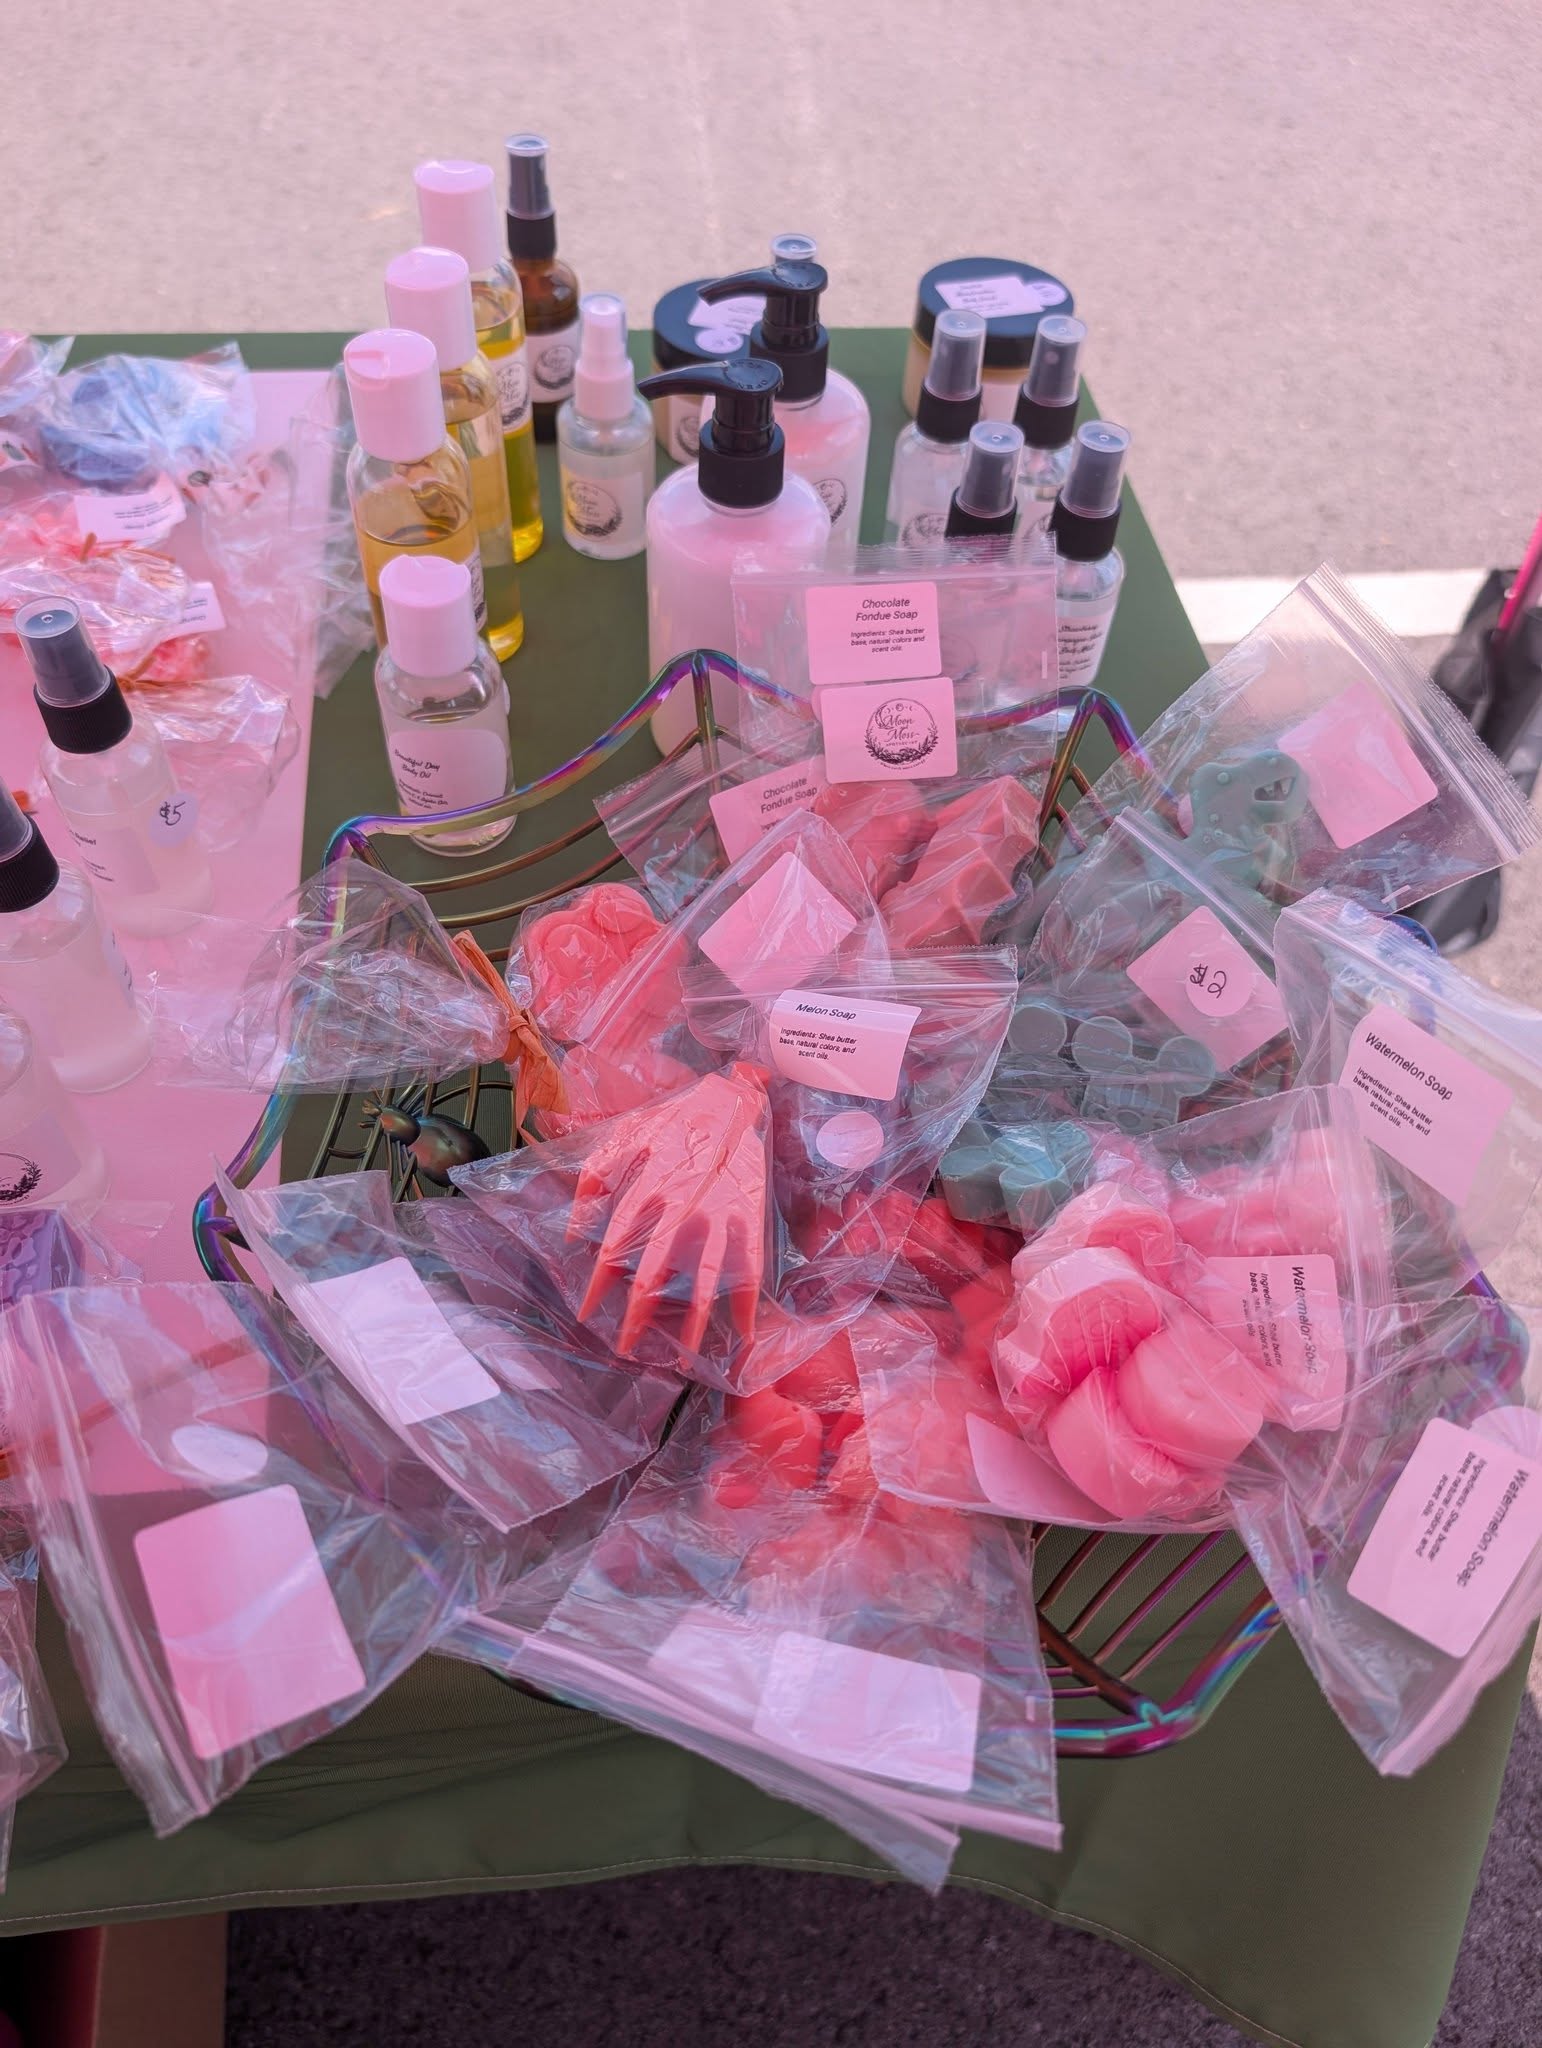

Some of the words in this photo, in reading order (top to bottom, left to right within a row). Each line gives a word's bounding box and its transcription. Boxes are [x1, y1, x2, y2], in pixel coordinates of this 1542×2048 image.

[856, 612, 891, 621] Fondue
[893, 610, 918, 620] Soap
[862, 598, 910, 609] Chocolate
[883, 714, 915, 729] Moon
[884, 727, 920, 742] Moss
[402, 764, 418, 777] Body
[419, 770, 431, 778] Oil
[425, 761, 440, 772] Day
[760, 796, 793, 814] Fondue
[795, 786, 818, 801] Soap
[763, 778, 807, 800] Chocolate
[159, 801, 186, 826] $5
[796, 1003, 829, 1015] Melon
[829, 1008, 857, 1020] Soap
[779, 1037, 795, 1046] base,
[796, 1040, 819, 1048] natural
[819, 1043, 841, 1052] colors,
[842, 1046, 856, 1054] and
[780, 1027, 817, 1039] Ingredients:
[818, 1033, 835, 1041] Shea
[836, 1036, 857, 1045] butter
[798, 1049, 815, 1058] scent
[1365, 1032, 1425, 1081] Watermelon
[1424, 1075, 1453, 1101] Soap
[1352, 1076, 1369, 1093] base,
[1370, 1089, 1394, 1109] natural
[1393, 1107, 1415, 1127] colors,
[1416, 1123, 1431, 1136] and
[1357, 1067, 1395, 1096] Ingredients:
[1394, 1094, 1411, 1110] Shea
[1411, 1107, 1433, 1126] butter
[1370, 1101, 1388, 1117] scent
[1388, 1115, 1401, 1128] oils.
[1264, 1351, 1274, 1367] and
[1272, 1343, 1283, 1367] butter
[1305, 1343, 1318, 1374] Soap
[1432, 1474, 1448, 1500] scent
[1442, 1476, 1461, 1508] natural
[1442, 1509, 1459, 1533] Shea
[1477, 1468, 1530, 1552] Watermelon
[1416, 1537, 1428, 1557] and
[1428, 1533, 1448, 1562] butter
[1457, 1551, 1484, 1588] Soap
